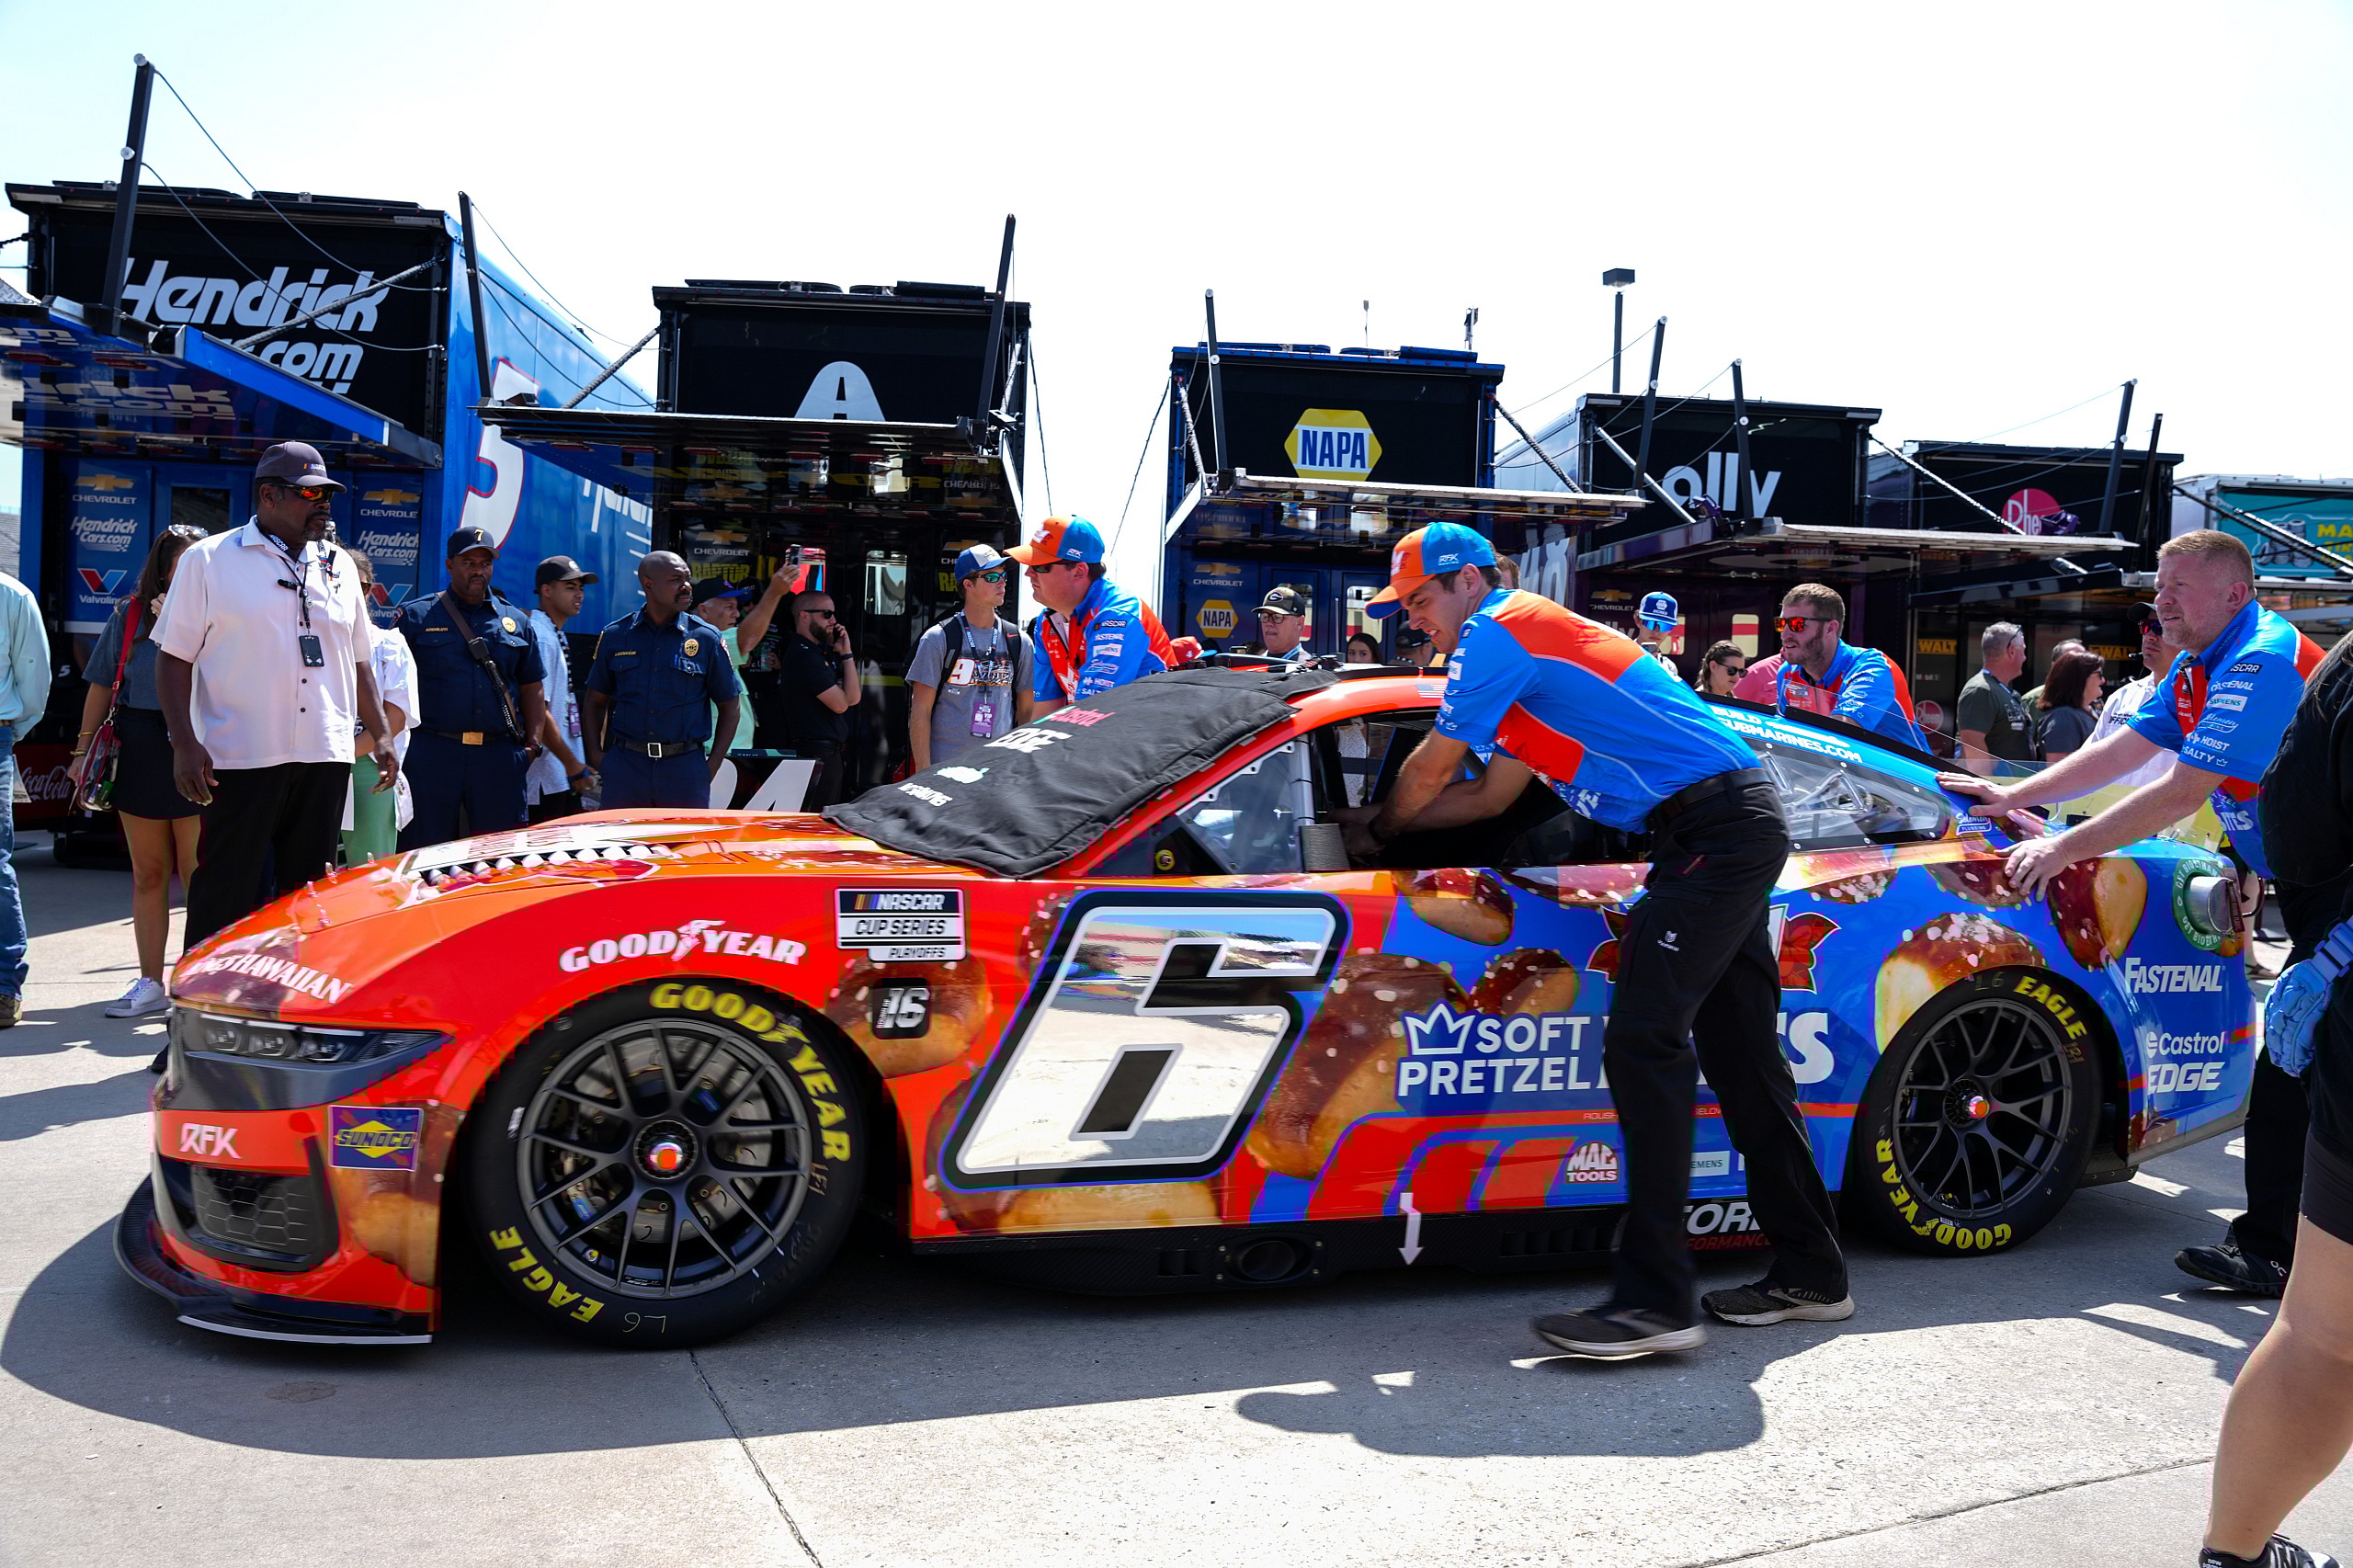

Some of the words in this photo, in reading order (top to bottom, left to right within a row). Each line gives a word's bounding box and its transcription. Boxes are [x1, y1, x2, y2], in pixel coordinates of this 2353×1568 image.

[121, 257, 390, 333] Hendrick
[794, 361, 886, 420] A
[1302, 429, 1367, 469] NAPA
[1662, 451, 1781, 518] ally
[73, 494, 137, 505] CHEVROLET
[360, 508, 418, 518] CHEVROLE
[2007, 488, 2041, 534] Rhe
[71, 517, 138, 535] Hendrick
[473, 528, 484, 542] 7
[80, 531, 132, 545] Cars.com
[368, 546, 418, 558] Cars.com
[693, 548, 750, 557] CHEVROLET
[690, 562, 750, 584] RAPTOR
[1193, 578, 1244, 587] CHEVROLET
[79, 595, 121, 605] Valvolin
[1203, 609, 1233, 628] NAPA
[1094, 633, 1125, 642] ASTENAL
[1606, 620, 1635, 639] lly
[1917, 640, 1956, 654] WALT
[58, 664, 71, 677] 5
[947, 657, 975, 686] 9
[2228, 663, 2261, 674] SCAR
[1082, 687, 1102, 696] SALT
[1711, 705, 1762, 725] BUILD
[1717, 717, 1863, 764] SUBMARINES.COM
[2200, 735, 2231, 752] HOIST
[2183, 746, 2216, 764] SALTY
[876, 893, 946, 911] NASCAR
[855, 919, 889, 936] CUP
[890, 919, 947, 936] SERIES
[560, 925, 807, 972] GOODYEAR
[889, 947, 947, 959] PLAYOFFS
[229, 954, 354, 1004] HAWAIIAN
[2124, 957, 2223, 994] FASTENAL
[883, 987, 931, 1028] 16
[2013, 975, 2088, 1040] EAGLE
[955, 905, 1336, 1176] 6
[1474, 1016, 1592, 1054] SOFT
[2157, 1031, 2225, 1057] Castrol
[648, 983, 853, 1164] GOODYEAR
[1397, 1056, 1593, 1096] PRETZEL
[2147, 1062, 2227, 1096] EDGE
[178, 1122, 242, 1159] RFK
[335, 1127, 418, 1150] SUNOCO
[1566, 1142, 1618, 1171] MAC
[1690, 1159, 1723, 1169] EMENS
[1566, 1171, 1618, 1182] TOOLS
[1875, 1138, 2012, 1250] GOODYEAR
[1683, 1201, 1761, 1234] OR
[1686, 1233, 1772, 1251] FORMANC
[489, 1225, 606, 1324] EAGLE
